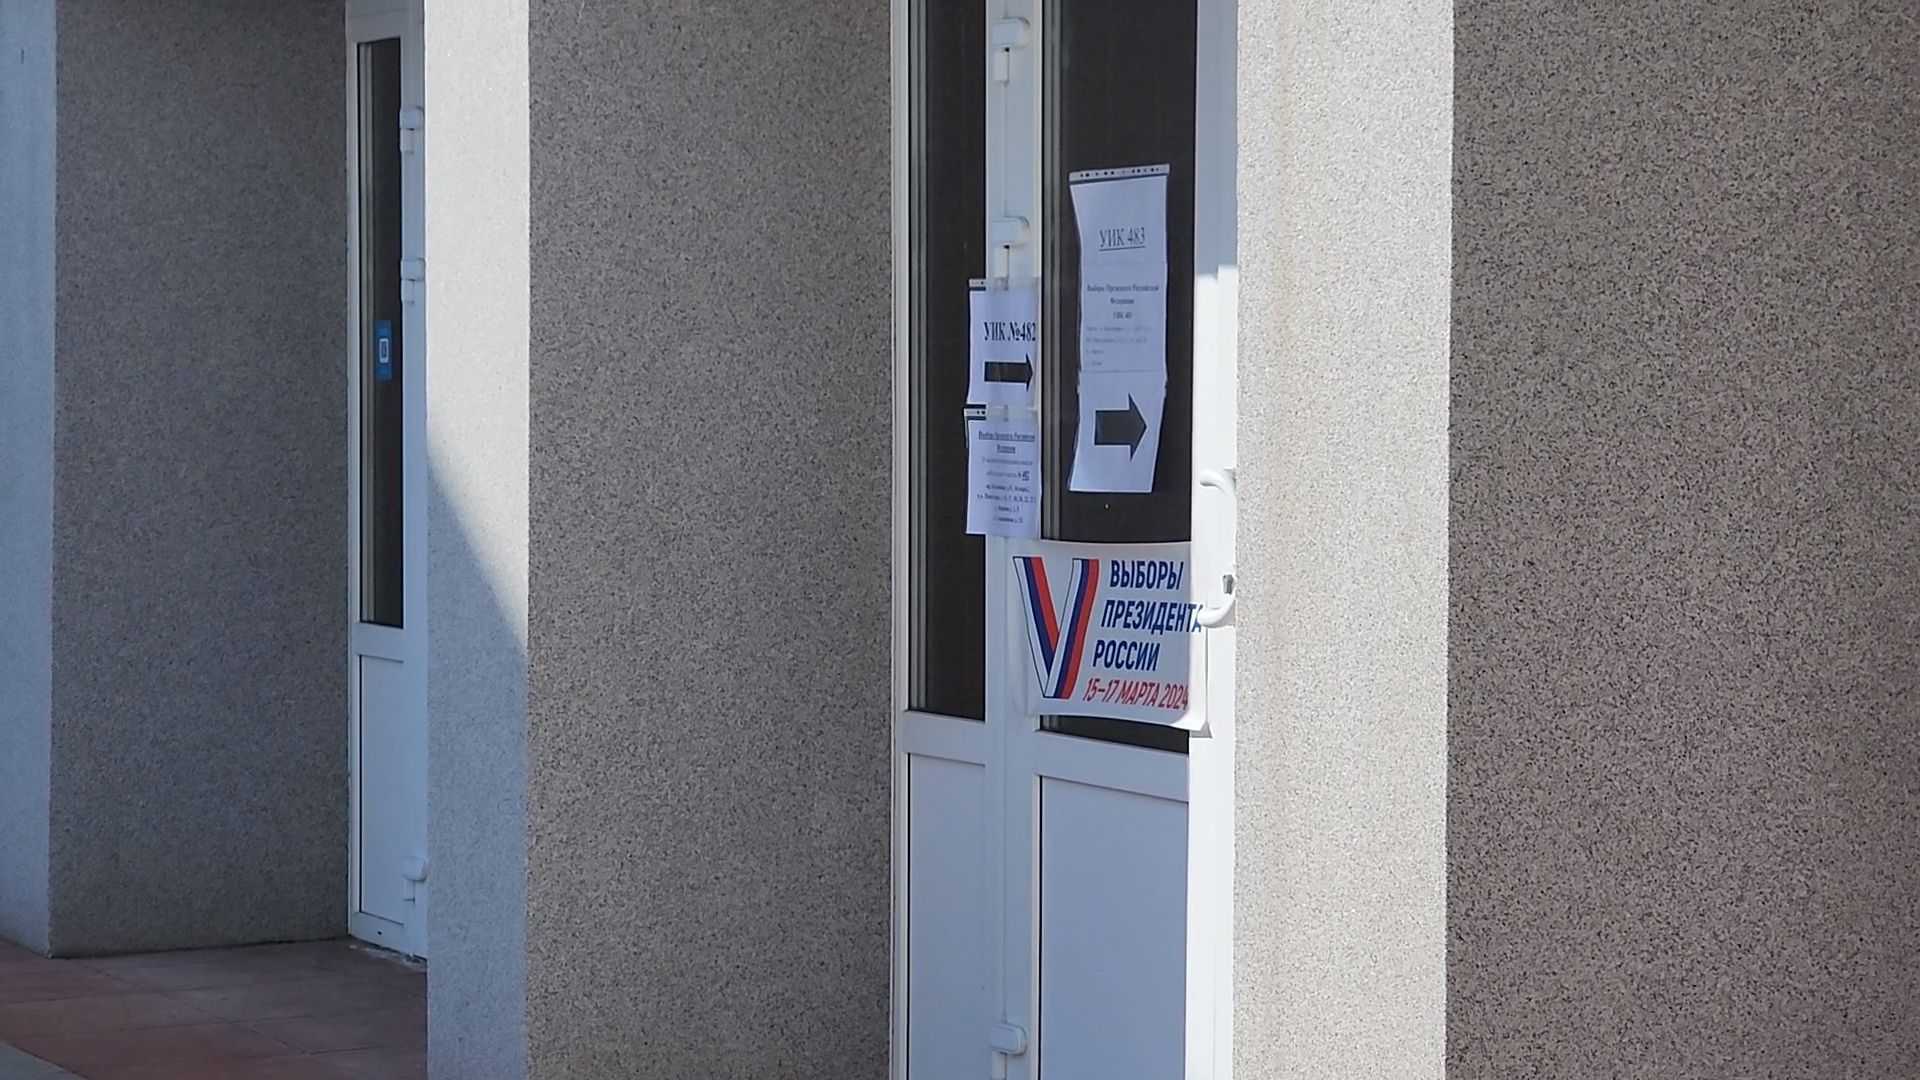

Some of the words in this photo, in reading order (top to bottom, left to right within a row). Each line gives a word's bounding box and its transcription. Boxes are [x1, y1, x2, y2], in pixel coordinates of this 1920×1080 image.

[1099, 229, 1125, 247] УИК
[1127, 226, 1145, 246] 483
[984, 322, 1006, 341] УИК
[1109, 559, 1184, 590] ВЫБОРЫ
[1092, 639, 1161, 671] РОССИИ
[1117, 680, 1160, 706] МАРТА
[1158, 683, 1189, 710] 2024
